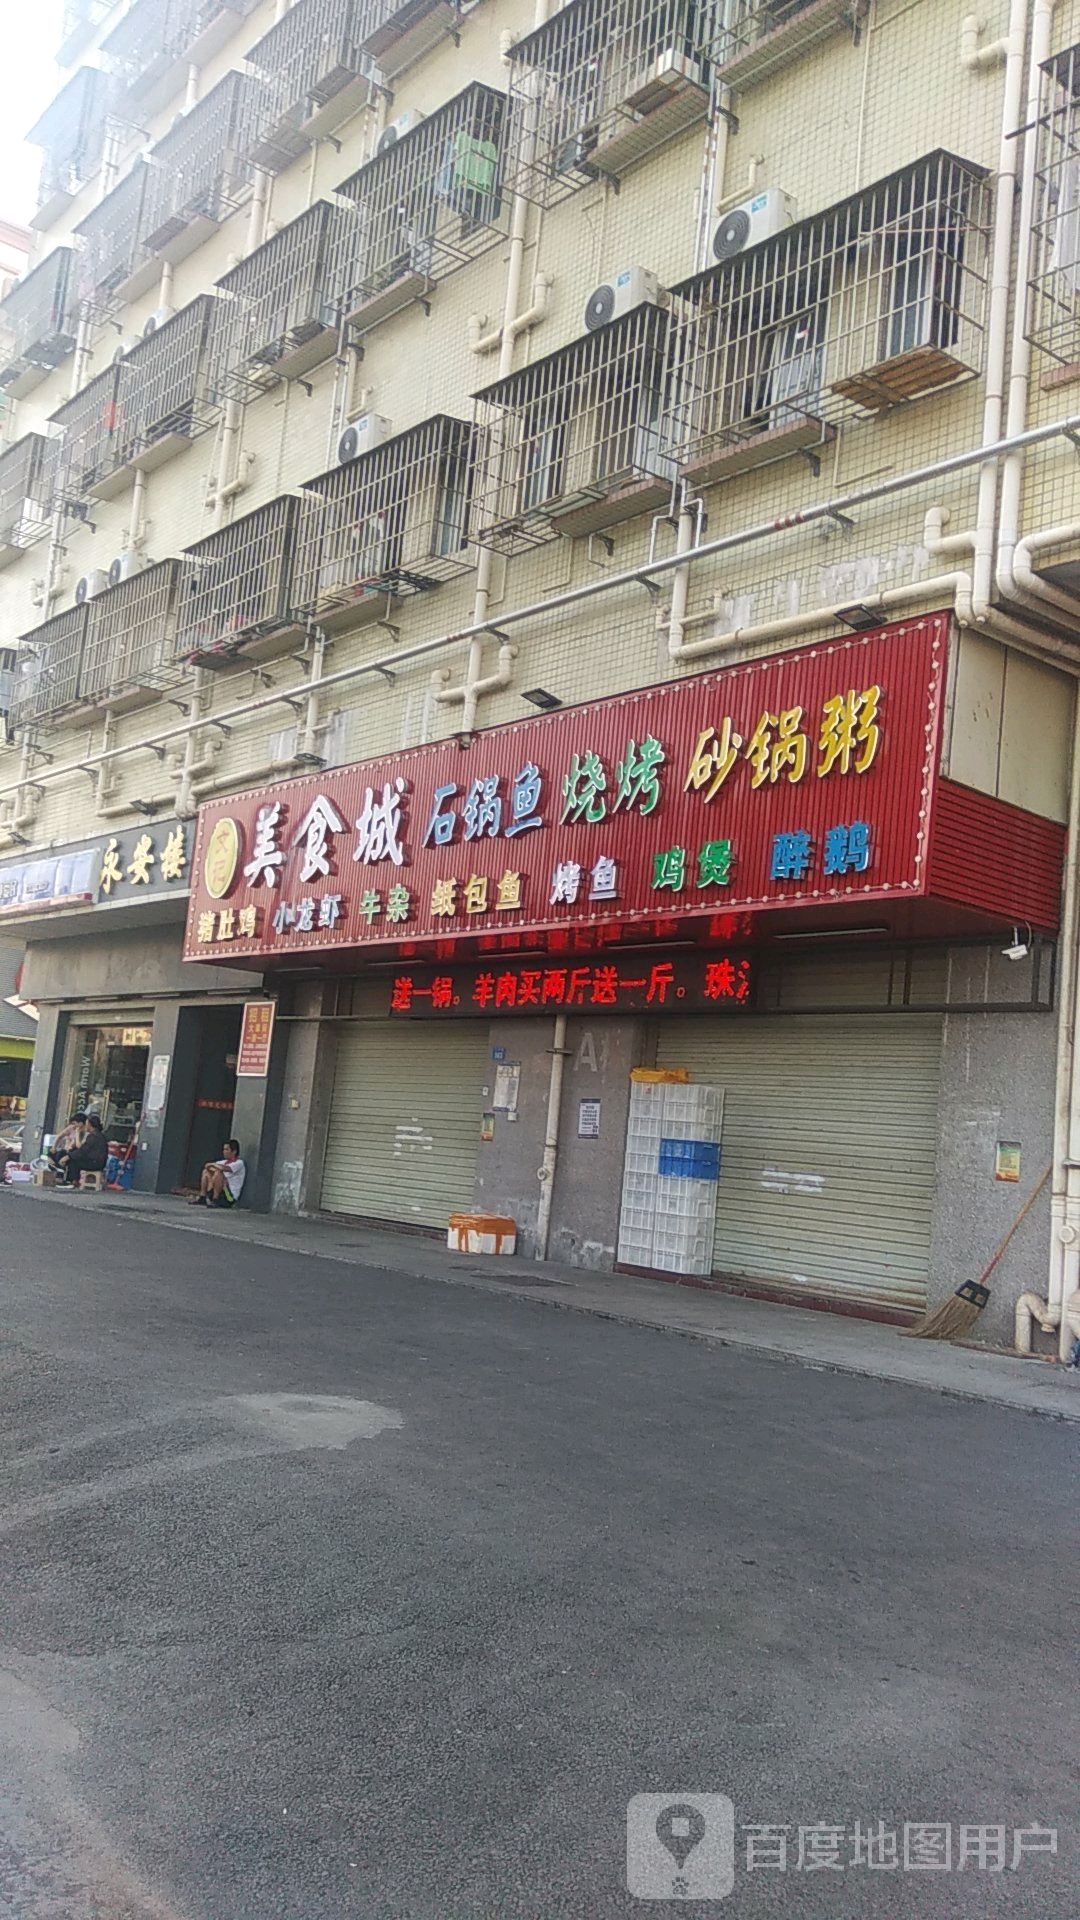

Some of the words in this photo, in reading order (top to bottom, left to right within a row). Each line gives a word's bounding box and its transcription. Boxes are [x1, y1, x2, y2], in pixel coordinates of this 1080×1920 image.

[243, 777, 407, 888] 美食城
[422, 761, 543, 848] 石锅鱼
[559, 734, 666, 826] 烧烤
[683, 684, 881, 804] 砂锅粥
[197, 904, 256, 943] 猪肚鸡
[272, 893, 342, 935] 小龙虾
[359, 883, 411, 925] 牛杂
[430, 869, 521, 918] 纸包鱼
[549, 855, 620, 906] 烤鱼
[651, 839, 733, 893] 鸡煲
[769, 820, 872, 881] 醉鹅
